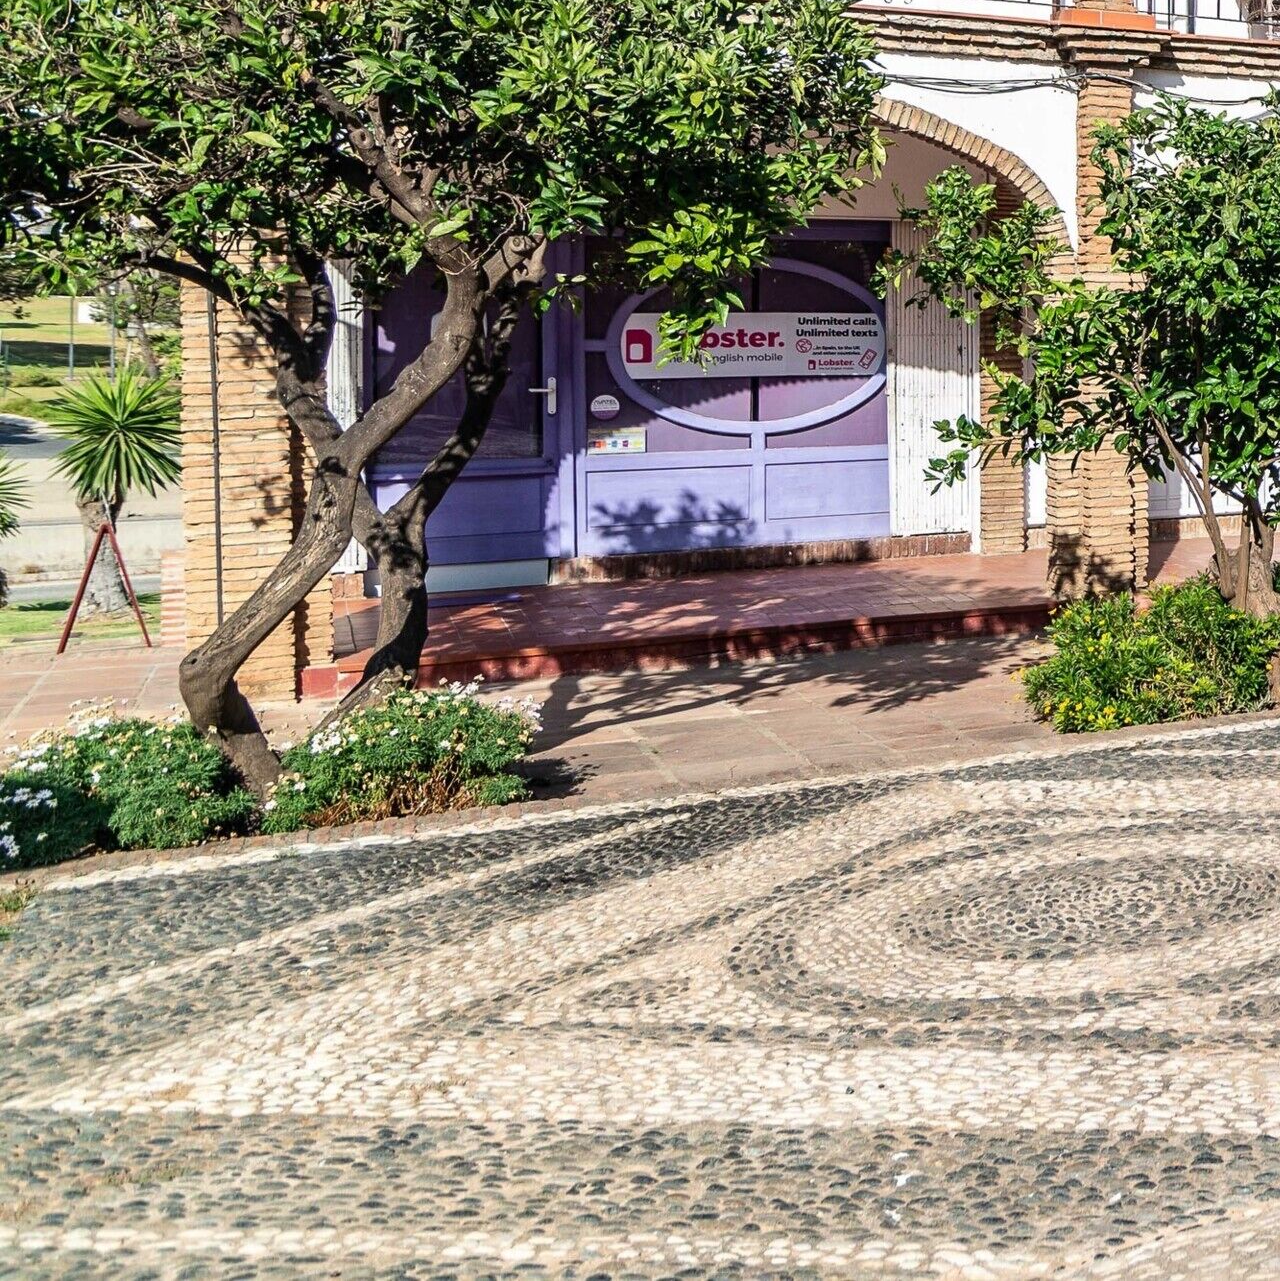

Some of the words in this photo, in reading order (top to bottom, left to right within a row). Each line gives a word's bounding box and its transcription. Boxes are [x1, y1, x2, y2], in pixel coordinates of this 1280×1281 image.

[797, 316, 851, 326] Unlimited
[853, 316, 877, 326] calls
[796, 328, 849, 337] Unlimited
[851, 329, 878, 338] texts
[701, 328, 785, 349] bster.
[747, 352, 784, 363] mobile
[818, 358, 855, 366] Lobster.
